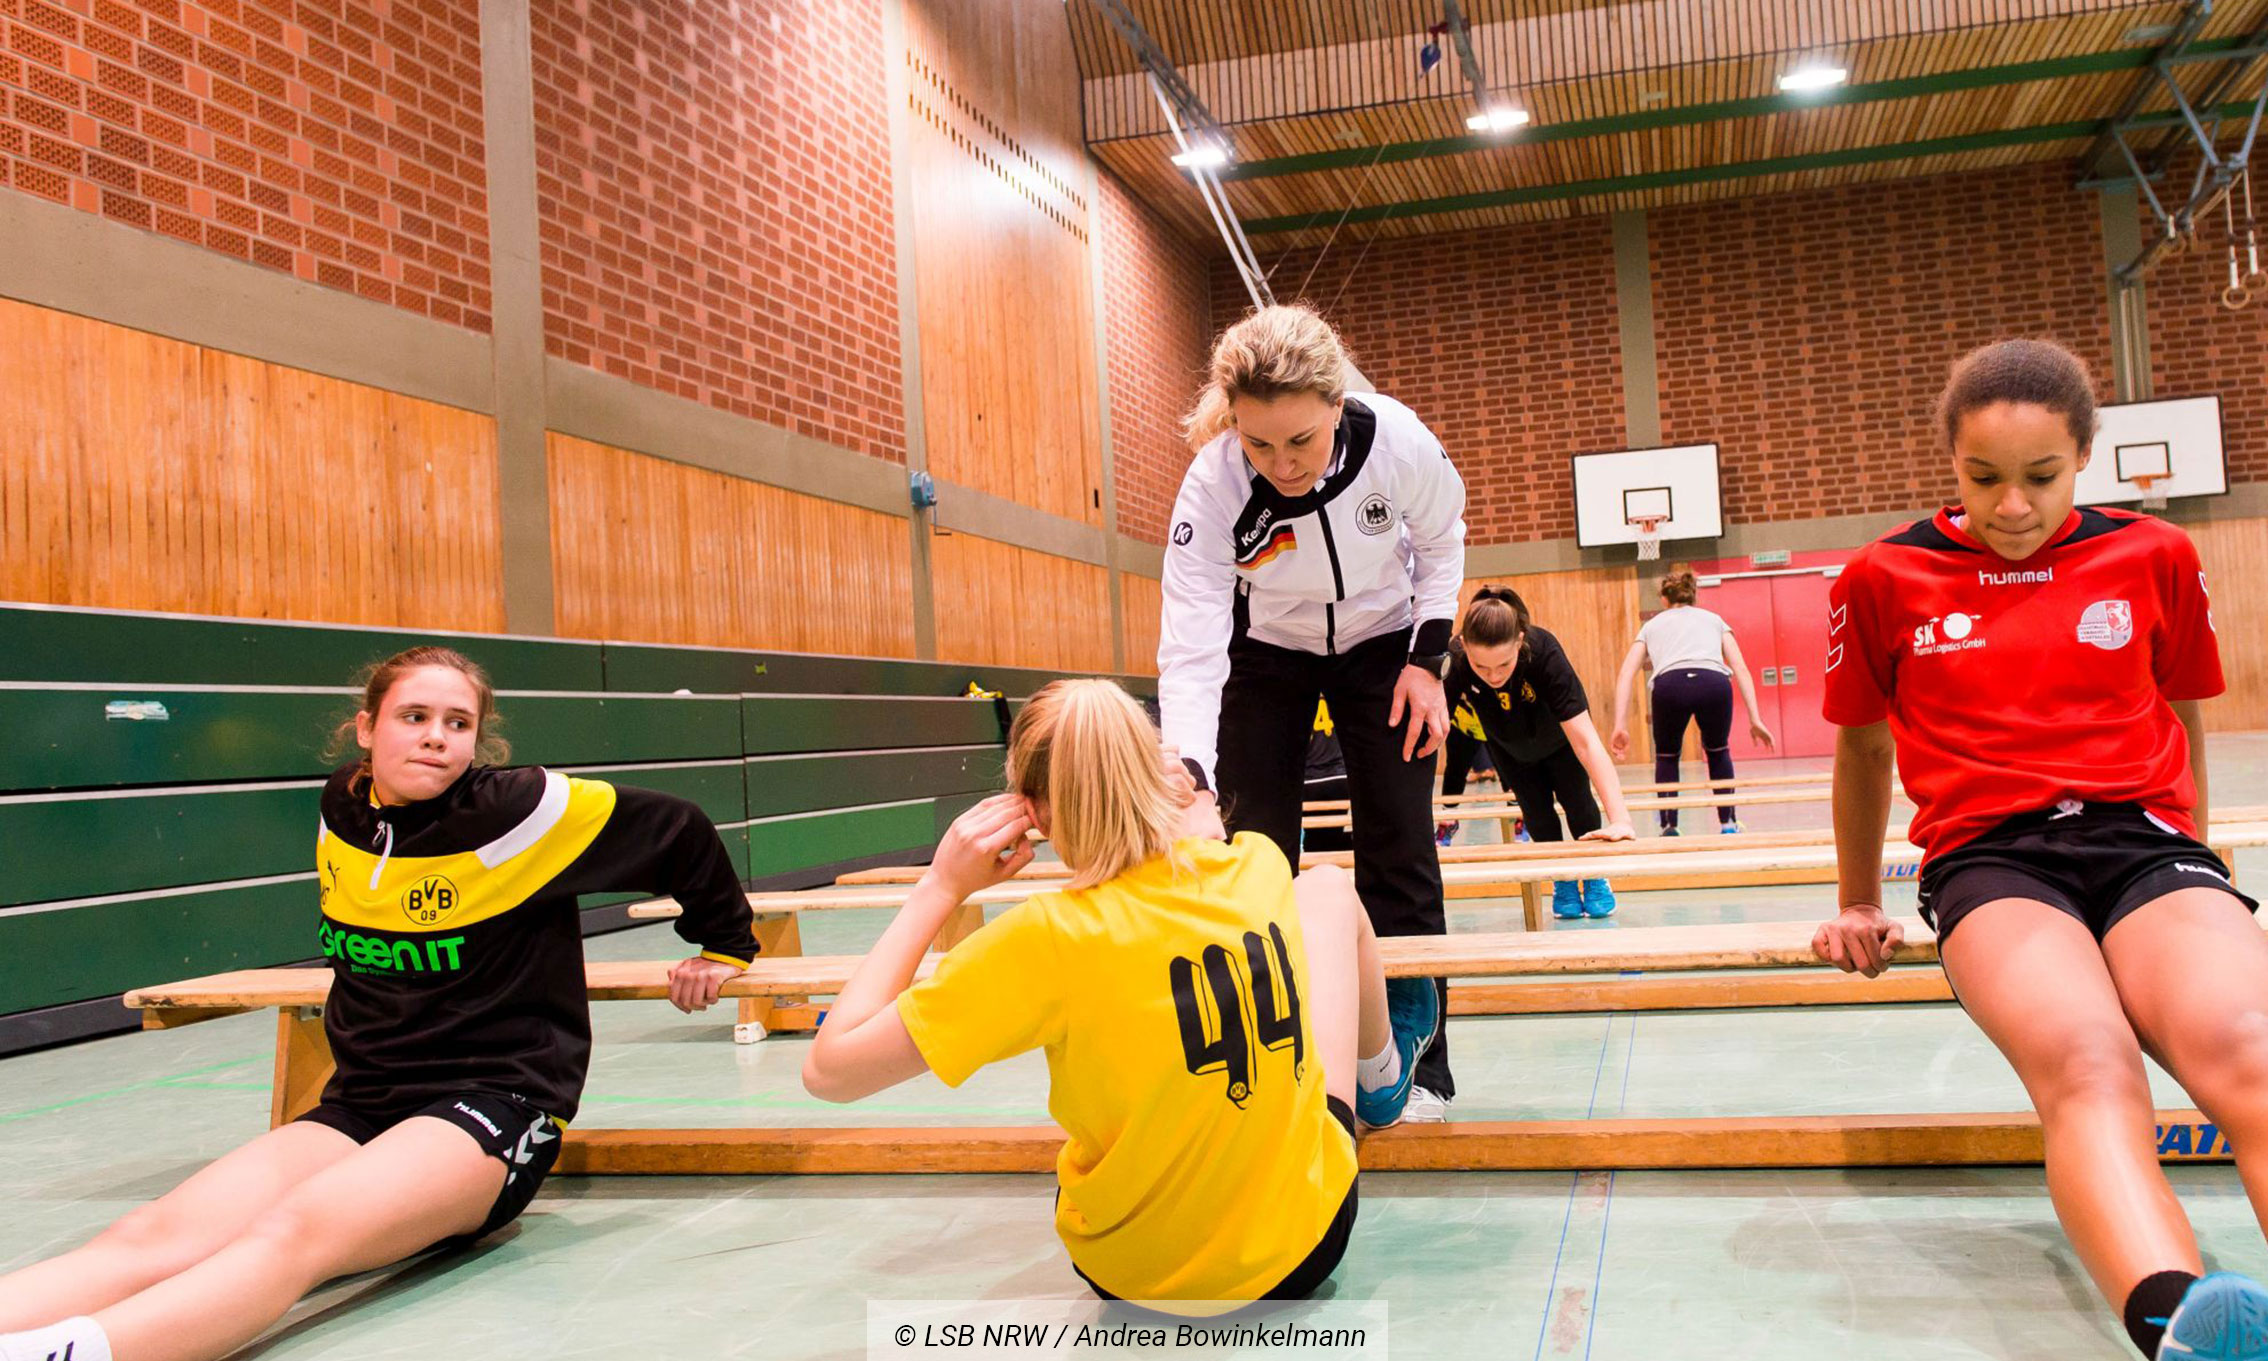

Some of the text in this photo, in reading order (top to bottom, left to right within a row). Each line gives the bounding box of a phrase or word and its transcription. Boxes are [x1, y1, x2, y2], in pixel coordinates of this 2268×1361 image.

[1241, 508, 1272, 546] Kempa
[1978, 566, 2053, 586] hummel
[1913, 622, 1936, 647] SK
[1962, 638, 1986, 649] GmbH
[409, 879, 453, 910] BVB
[421, 910, 437, 921] 09
[1169, 921, 1304, 1110] 44
[453, 1101, 502, 1137] hummel
